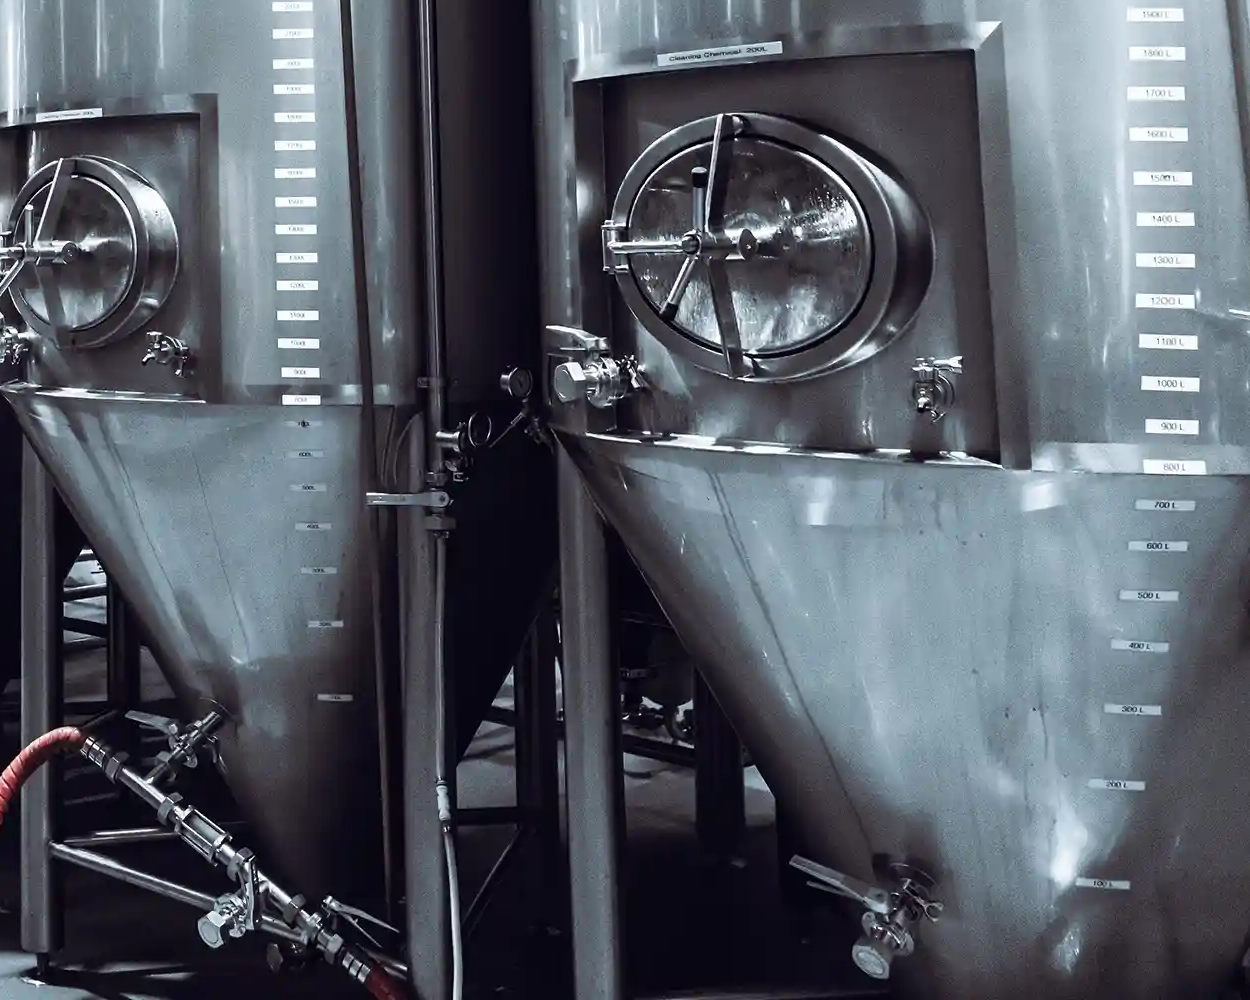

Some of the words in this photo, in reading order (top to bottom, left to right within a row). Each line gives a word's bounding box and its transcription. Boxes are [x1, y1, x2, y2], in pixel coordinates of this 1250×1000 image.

[1143, 49, 1164, 57] 1800
[1165, 49, 1171, 57] L
[1146, 89, 1166, 97] 1700
[1168, 89, 1175, 97] L
[1169, 130, 1175, 138] L
[1150, 174, 1170, 182] 1500
[1172, 174, 1178, 182] L
[1152, 215, 1173, 223] 1400
[1174, 215, 1180, 223] L
[1153, 256, 1174, 264] 1300
[1175, 256, 1181, 264] L
[1151, 296, 1175, 305] 1200
[1178, 296, 1183, 305] L
[1156, 337, 1177, 346] 1100
[1179, 338, 1184, 346] L
[1157, 379, 1178, 387] 1000
[1179, 379, 1185, 388] L
[1160, 422, 1177, 430] 900
[1179, 423, 1184, 431] L
[1163, 463, 1179, 471] 800
[1181, 463, 1186, 471] L
[1154, 501, 1170, 509] 700
[1137, 591, 1154, 599] 500
[1145, 642, 1150, 650] L
[1121, 705, 1137, 713] 300
